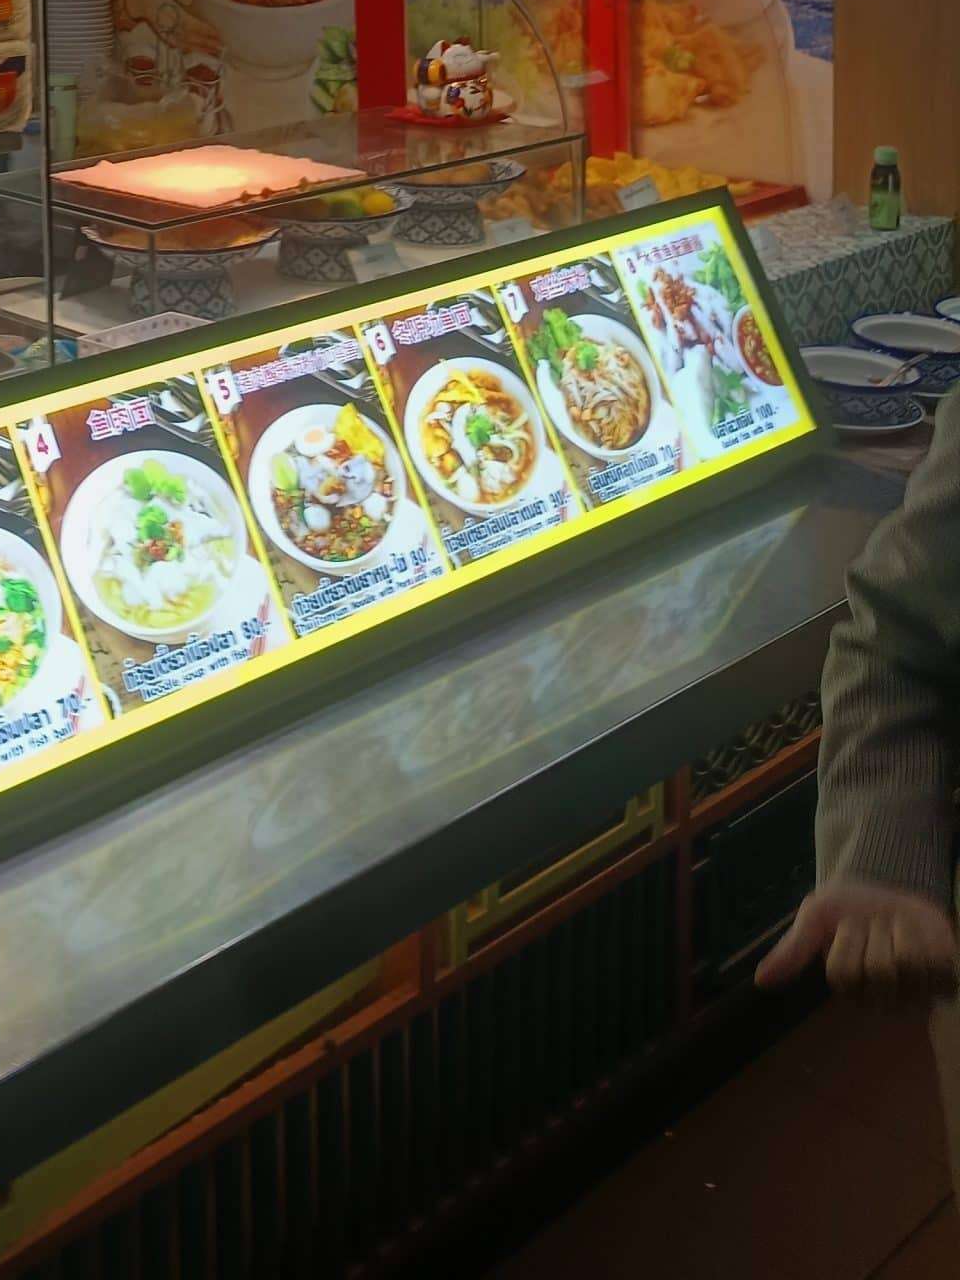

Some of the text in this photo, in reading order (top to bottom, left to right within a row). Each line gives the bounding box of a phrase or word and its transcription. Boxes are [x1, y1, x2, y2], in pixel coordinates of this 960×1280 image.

[377, 333, 386, 351] 6
[218, 379, 230, 399] 5
[36, 433, 50, 455] 4
